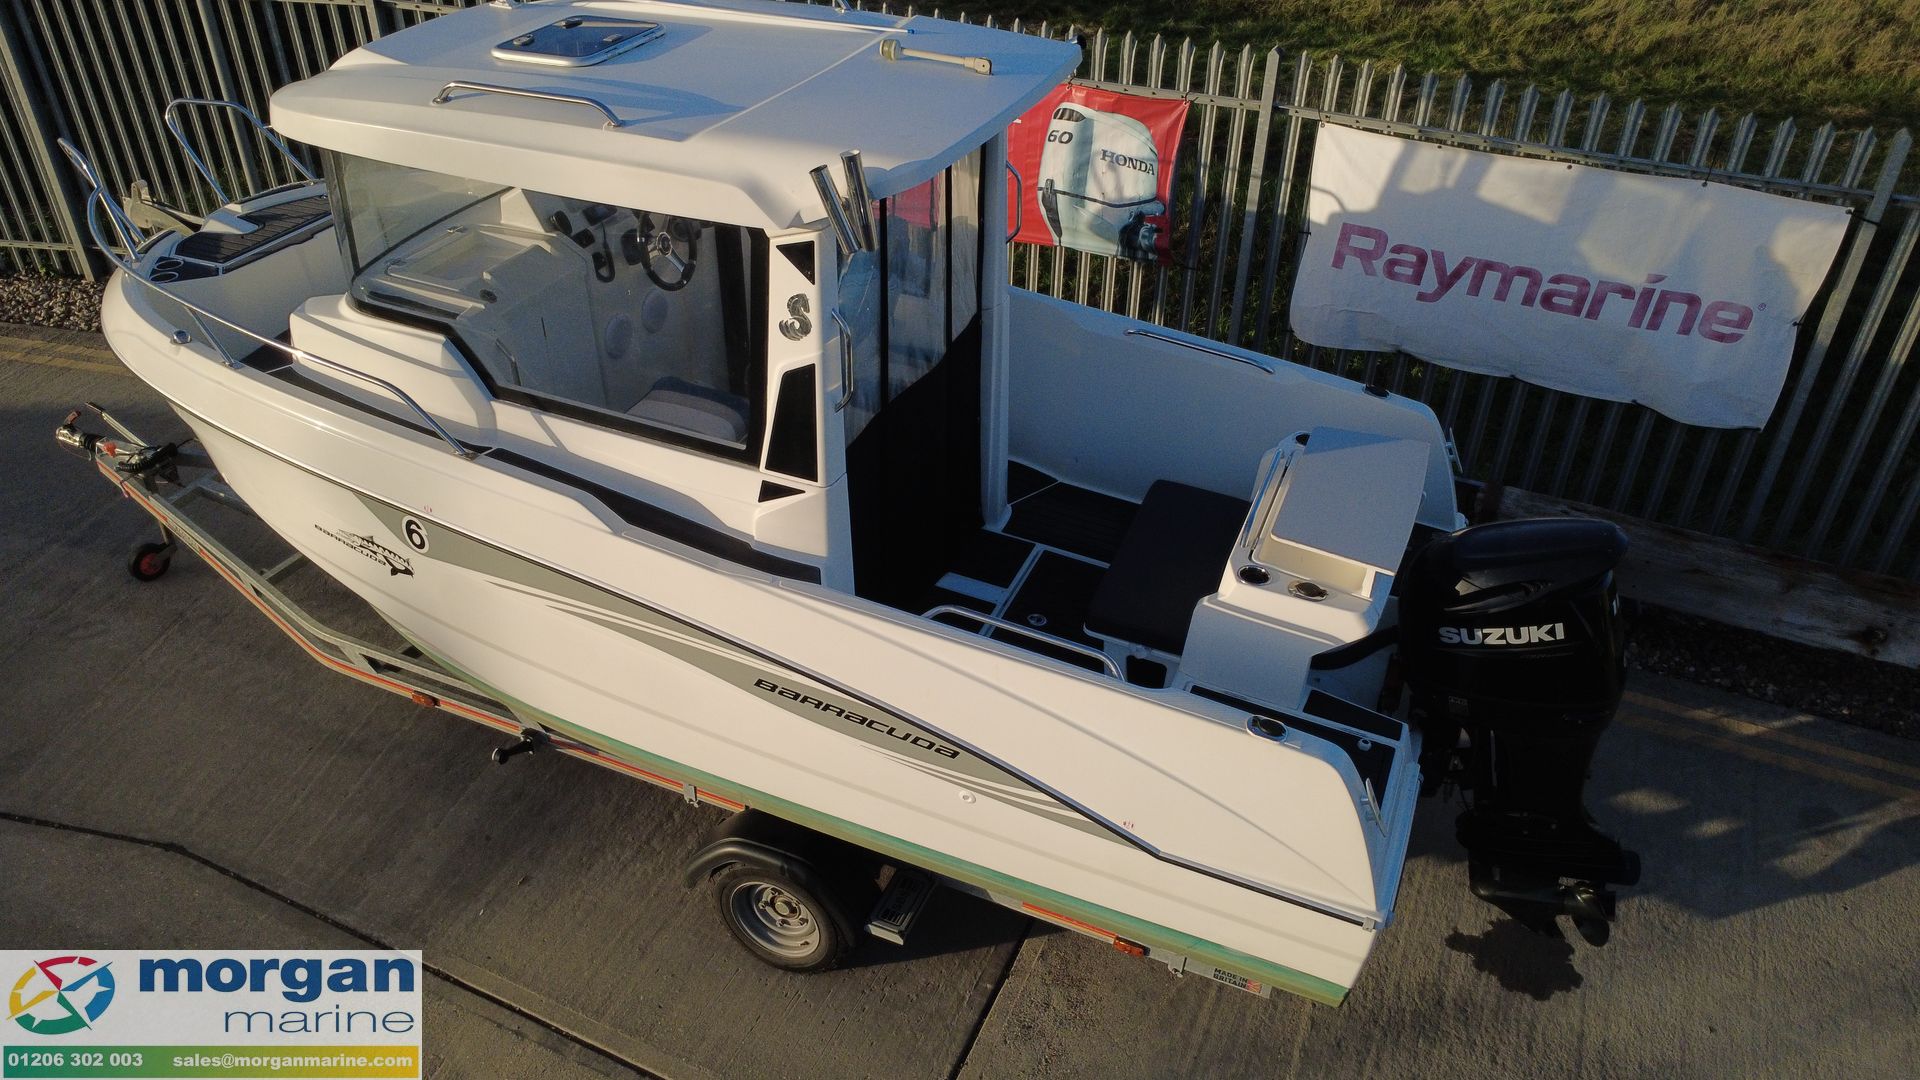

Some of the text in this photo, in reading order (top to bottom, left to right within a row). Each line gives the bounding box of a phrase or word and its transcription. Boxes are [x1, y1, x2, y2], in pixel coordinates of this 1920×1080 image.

[1048, 129, 1074, 145] 60
[1100, 149, 1156, 176] HONDA
[1331, 222, 1754, 344] Raymarine
[405, 519, 426, 550] 6
[1438, 622, 1565, 645] SUZUKI
[1213, 974, 1247, 988] BRITAIN
[1214, 968, 1238, 979] MADE
